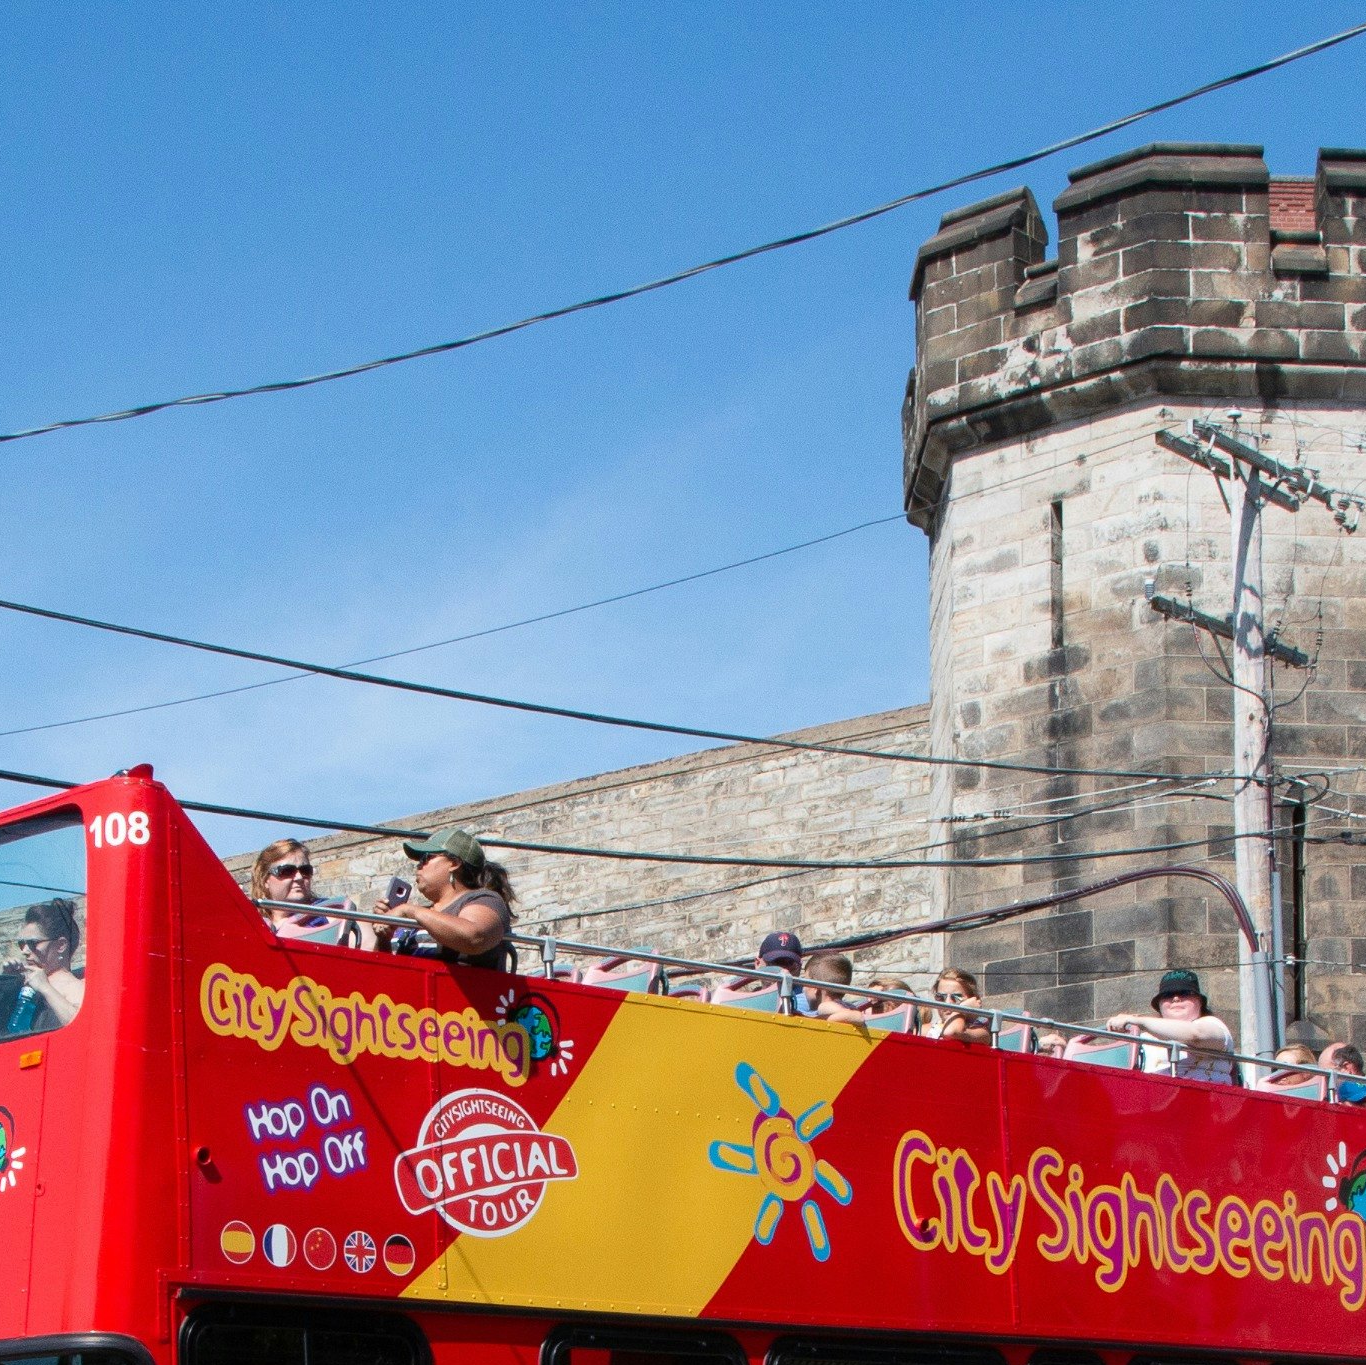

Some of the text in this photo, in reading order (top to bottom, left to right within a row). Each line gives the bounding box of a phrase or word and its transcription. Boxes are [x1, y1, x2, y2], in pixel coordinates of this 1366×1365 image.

[89, 811, 151, 849] 108
[200, 962, 530, 1087] CitySightseeing
[247, 1086, 351, 1139] Hop On
[434, 1098, 526, 1139] CITYSIGHTSEEING
[262, 1131, 366, 1190] Hop Off
[415, 1139, 569, 1199] OFFICIAL
[468, 1187, 536, 1227] TOUR
